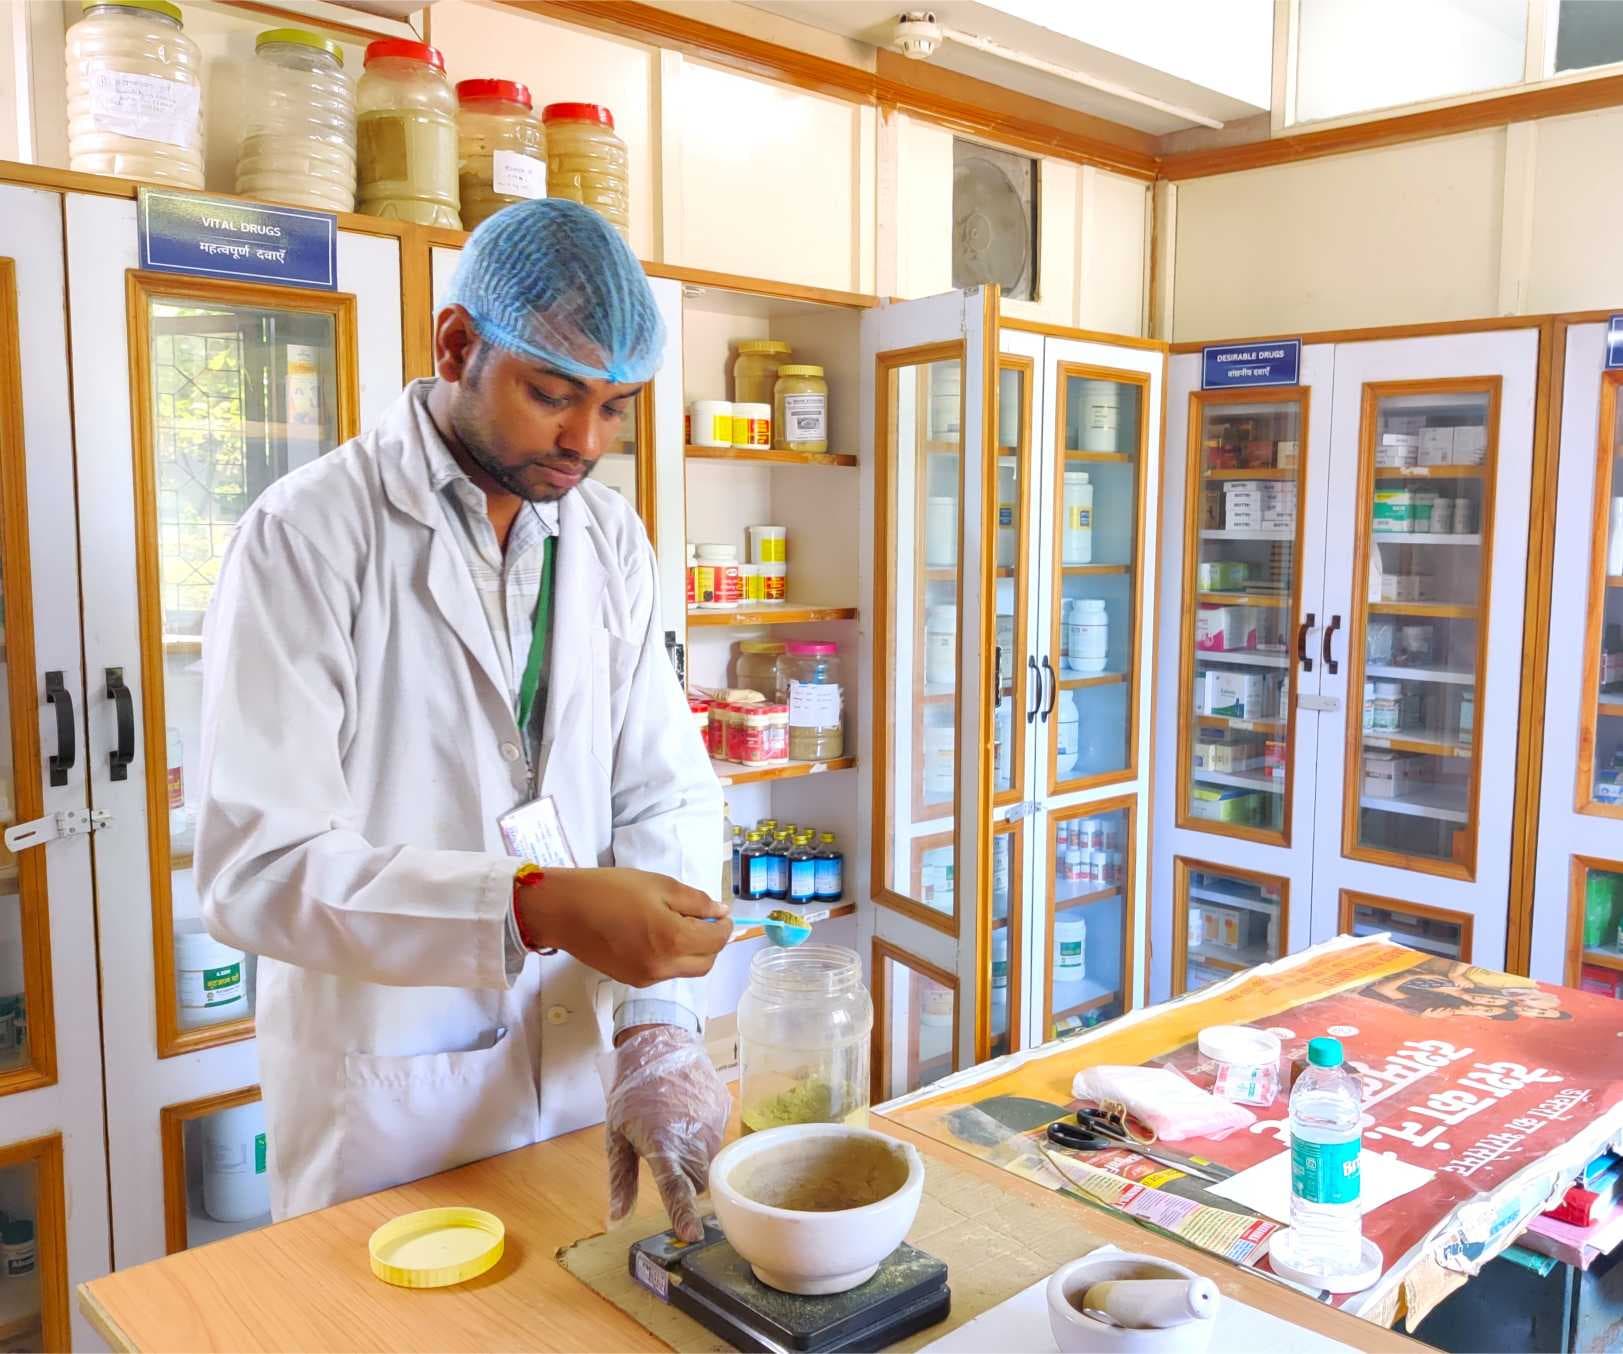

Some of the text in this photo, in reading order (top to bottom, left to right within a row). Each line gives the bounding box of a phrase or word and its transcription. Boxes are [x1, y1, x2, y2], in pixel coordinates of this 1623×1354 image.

[201, 216, 281, 237] VITAL DRUGS
[1216, 350, 1285, 363] DESIRABLE DRUGS
[1457, 1061, 1565, 1098] देश
[1407, 1089, 1499, 1125] का
[1504, 1117, 1548, 1134] का
